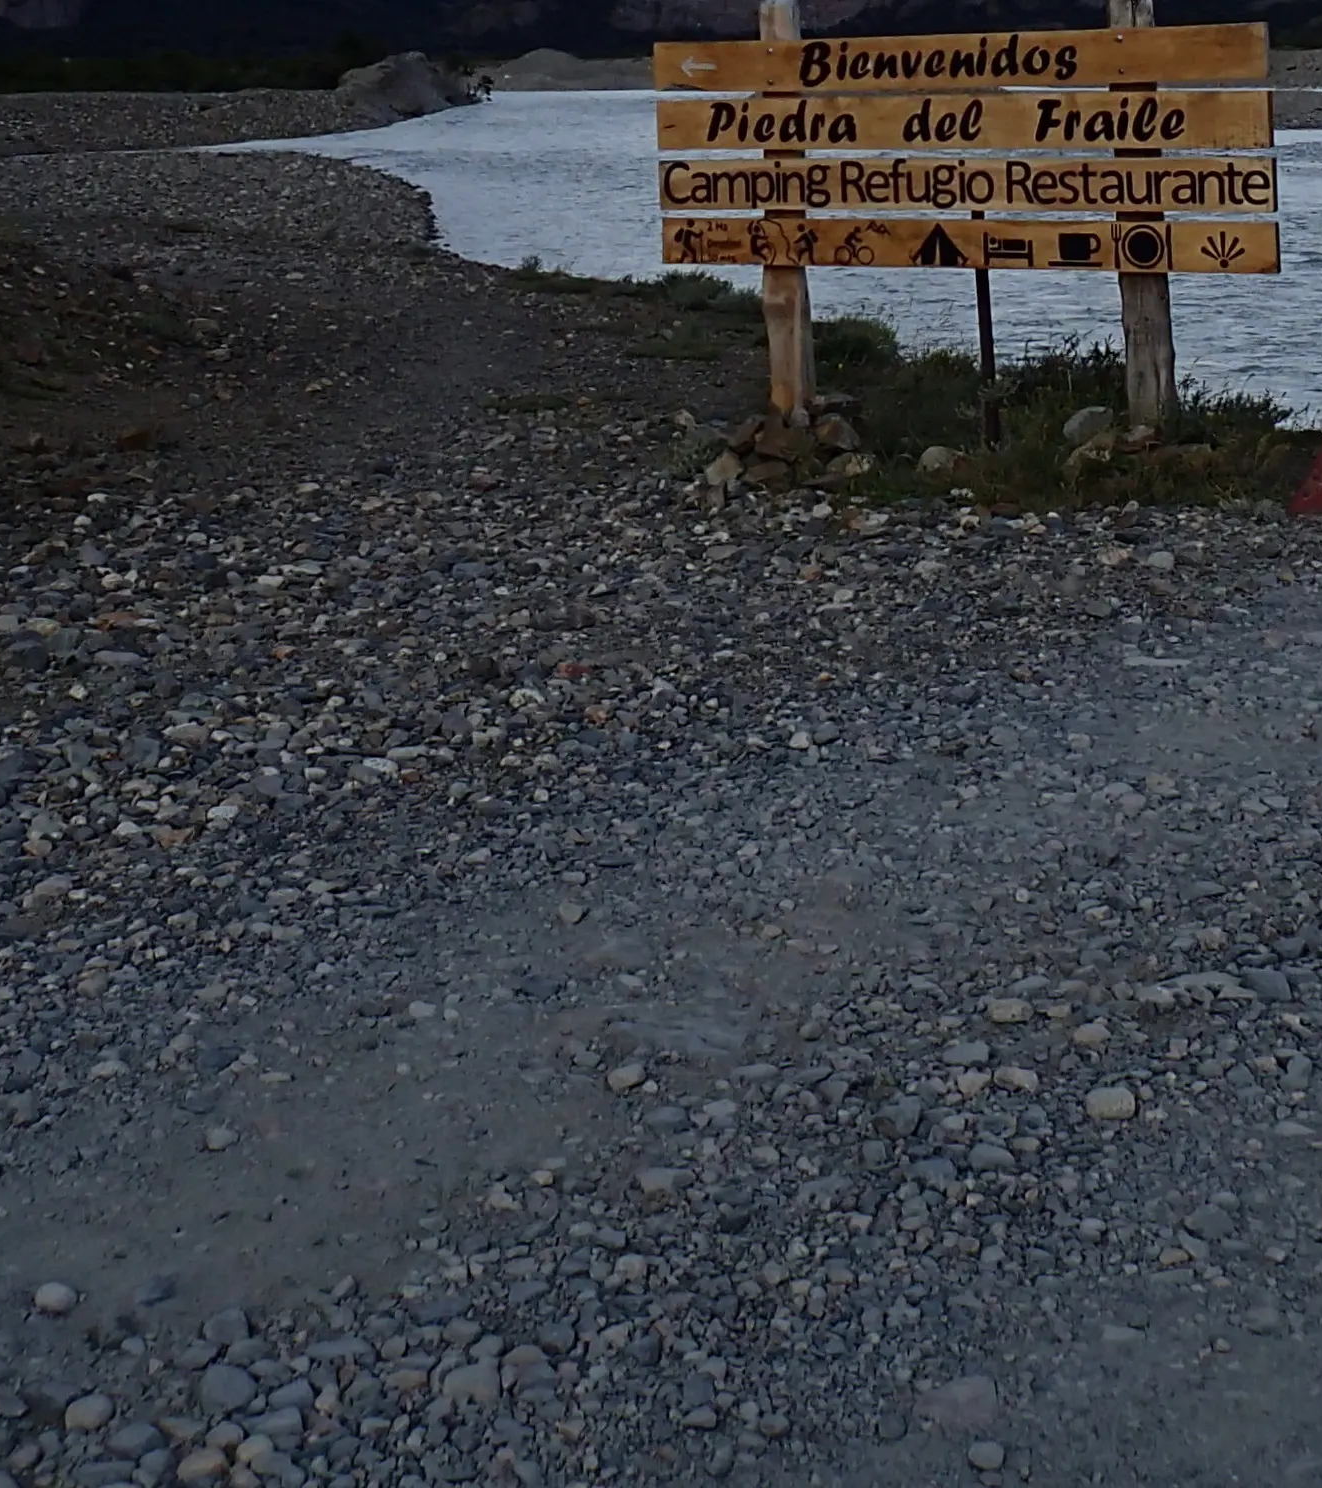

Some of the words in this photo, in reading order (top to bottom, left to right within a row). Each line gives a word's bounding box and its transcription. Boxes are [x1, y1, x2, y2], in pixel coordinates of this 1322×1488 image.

[799, 34, 1078, 88] Bienvenidos
[706, 99, 857, 143] Piedra
[902, 98, 983, 143] del
[1035, 96, 1185, 143] Fraile
[663, 160, 831, 209] Camping
[840, 159, 995, 209] Refugio
[1005, 160, 1271, 205] Restaurante
